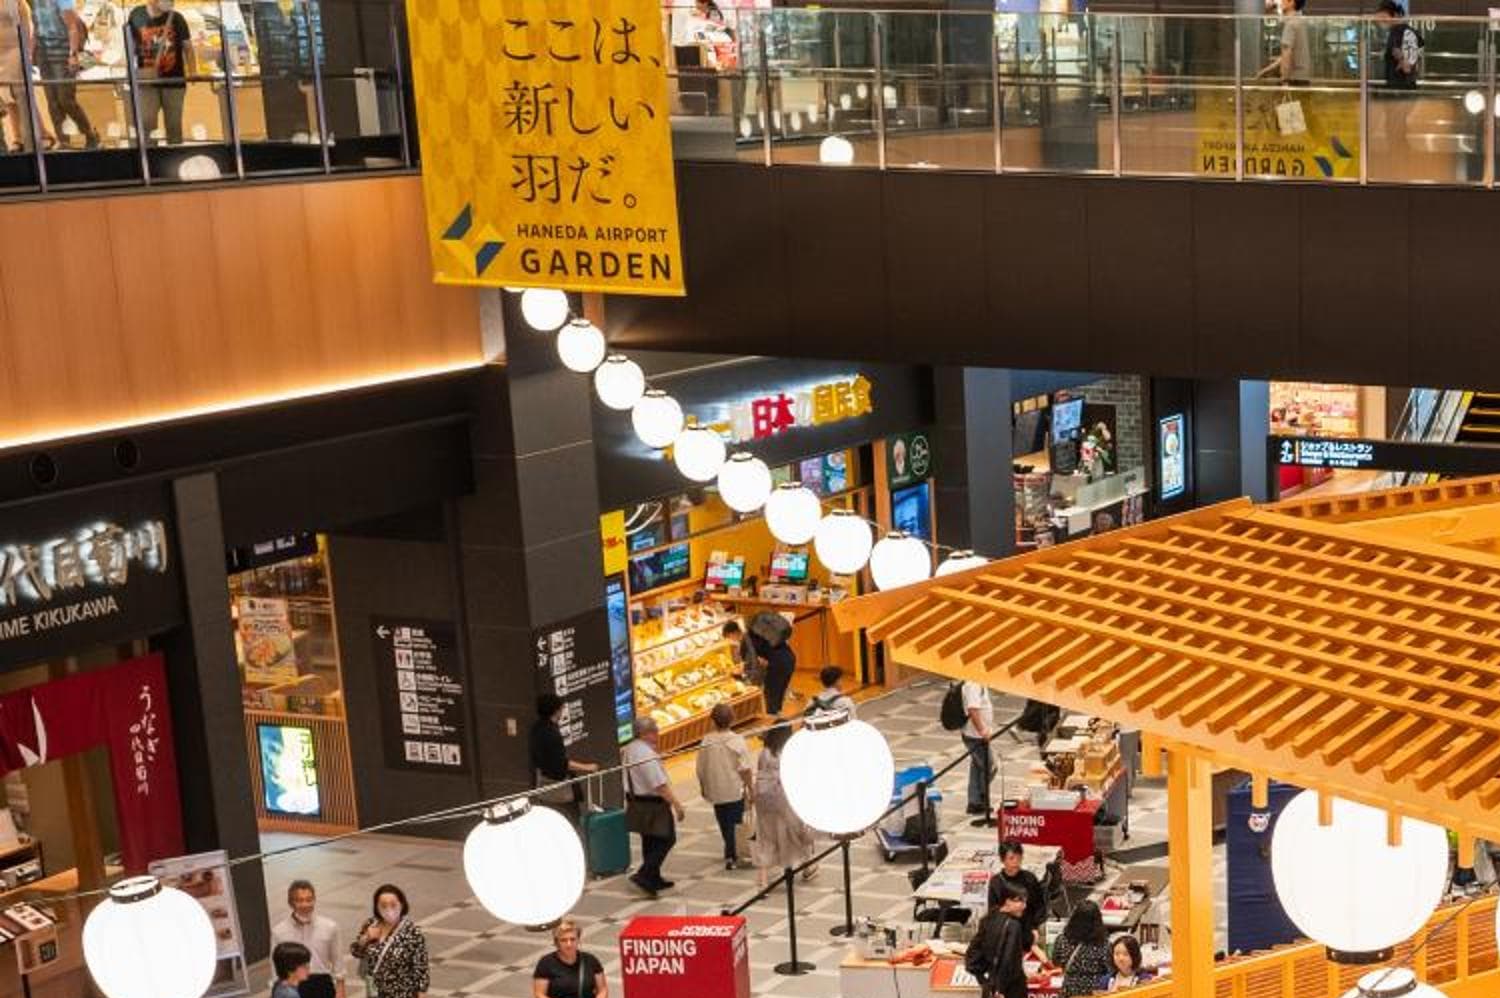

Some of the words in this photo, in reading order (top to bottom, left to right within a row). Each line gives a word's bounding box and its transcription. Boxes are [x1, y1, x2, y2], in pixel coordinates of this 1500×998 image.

[502, 17, 661, 68] ここは、
[503, 80, 655, 136] 新しい
[511, 154, 637, 208] 羽だ。
[517, 223, 588, 240] HANEDA
[595, 226, 668, 244] AIRPORT
[520, 248, 672, 281] GARDEN
[0, 616, 30, 640] IME
[33, 595, 120, 632] KIKUKAWA
[622, 939, 697, 957] FINDING
[625, 957, 686, 975] JAPAN
